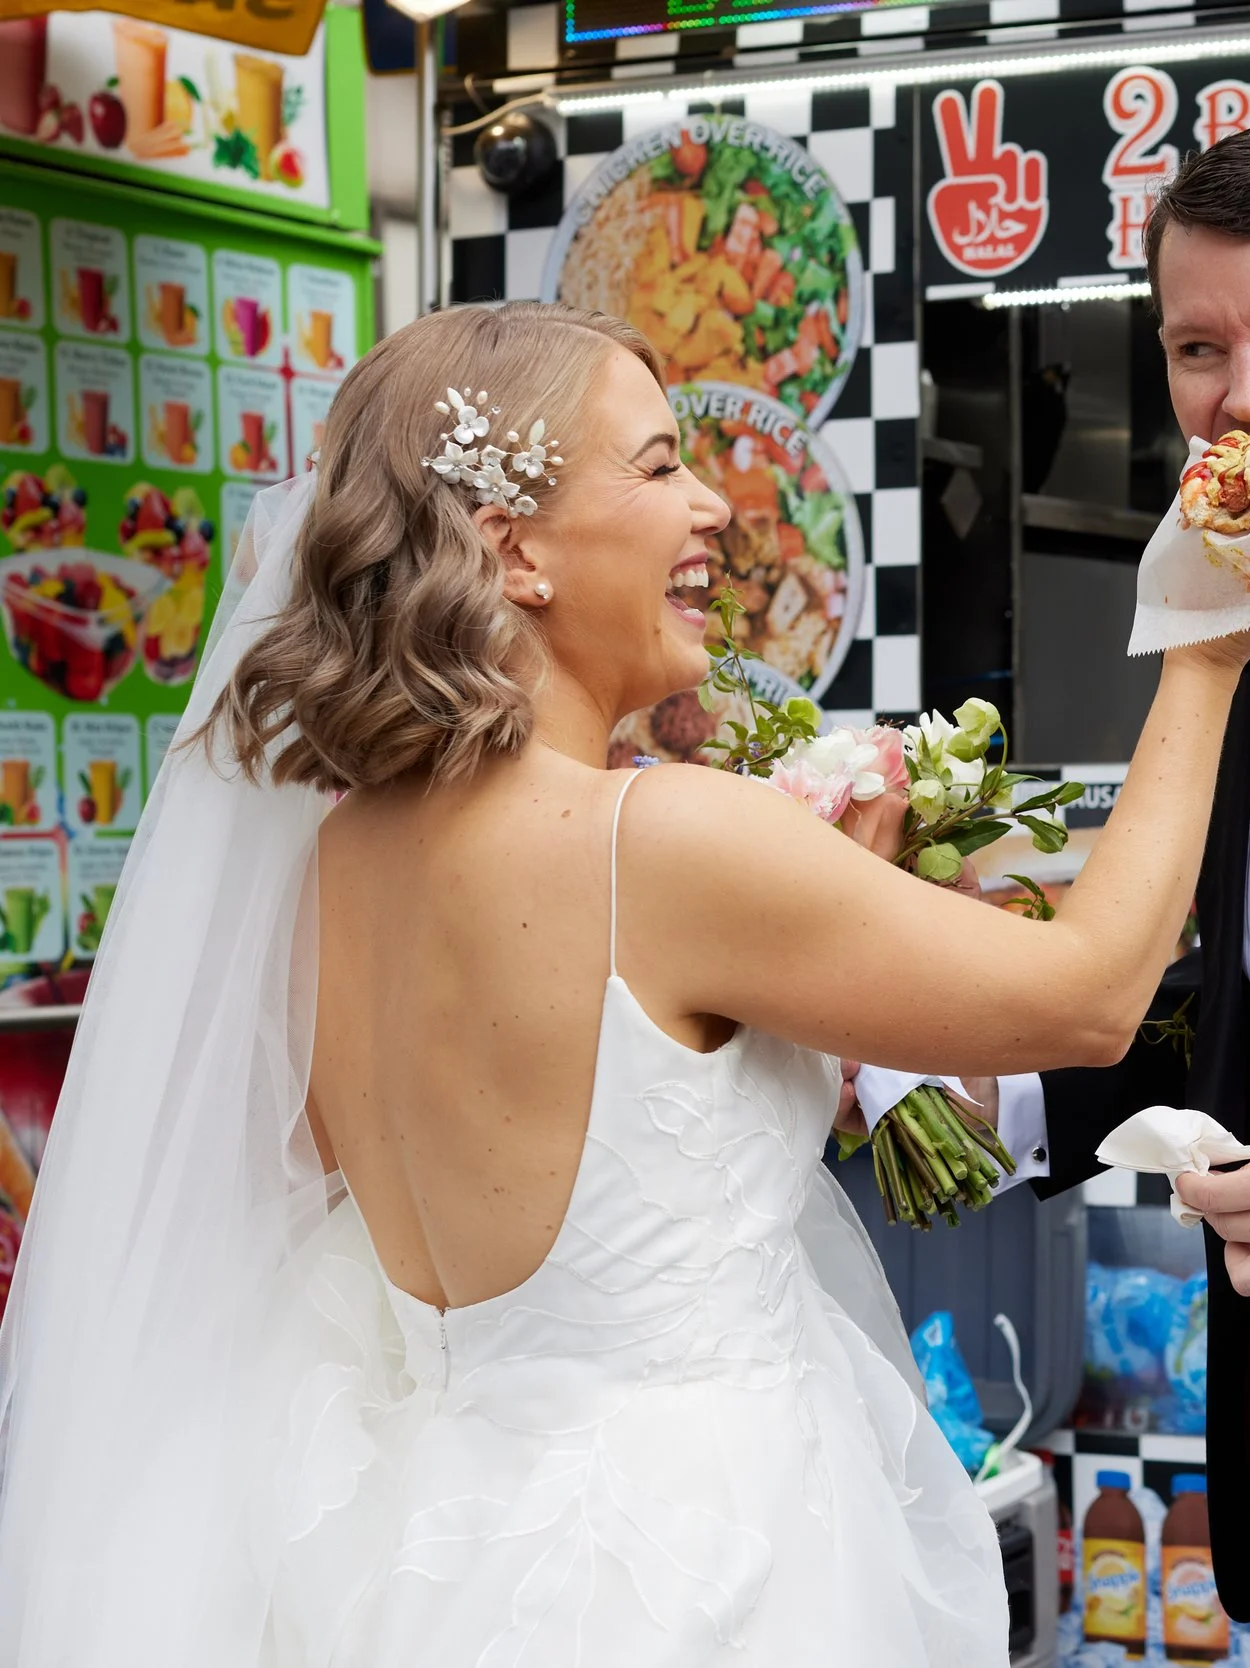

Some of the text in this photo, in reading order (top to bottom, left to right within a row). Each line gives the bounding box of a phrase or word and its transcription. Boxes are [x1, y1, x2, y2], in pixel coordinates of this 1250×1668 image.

[574, 117, 828, 222] CHICKEN OVER RICE
[1103, 66, 1180, 187] 2
[669, 391, 808, 458] OVER RICE
